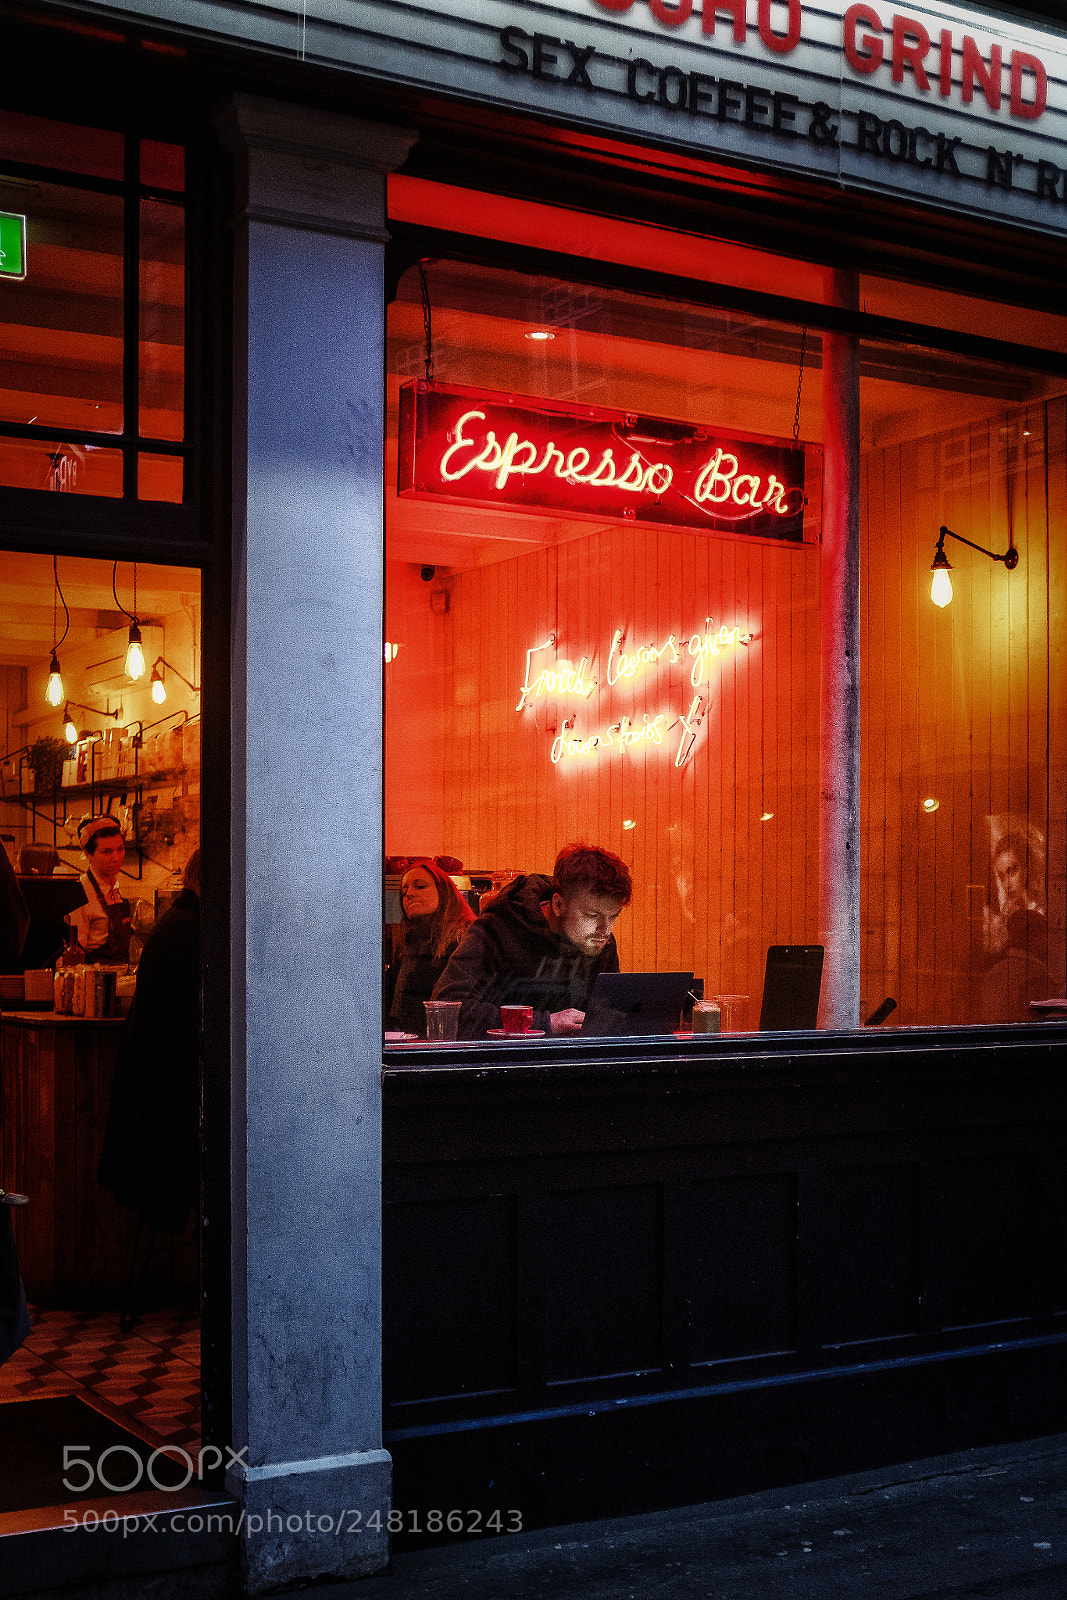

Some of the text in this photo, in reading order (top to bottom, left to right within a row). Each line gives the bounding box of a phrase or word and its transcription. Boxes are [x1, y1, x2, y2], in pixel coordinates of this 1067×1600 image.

[500, 25, 597, 91] SEX
[627, 58, 798, 138] COFFEE
[809, 101, 840, 146] &
[857, 110, 963, 177] ROCK
[1037, 158, 1067, 201] R
[592, 0, 1048, 120] HO GRIND
[440, 410, 789, 514] Espresso Bar
